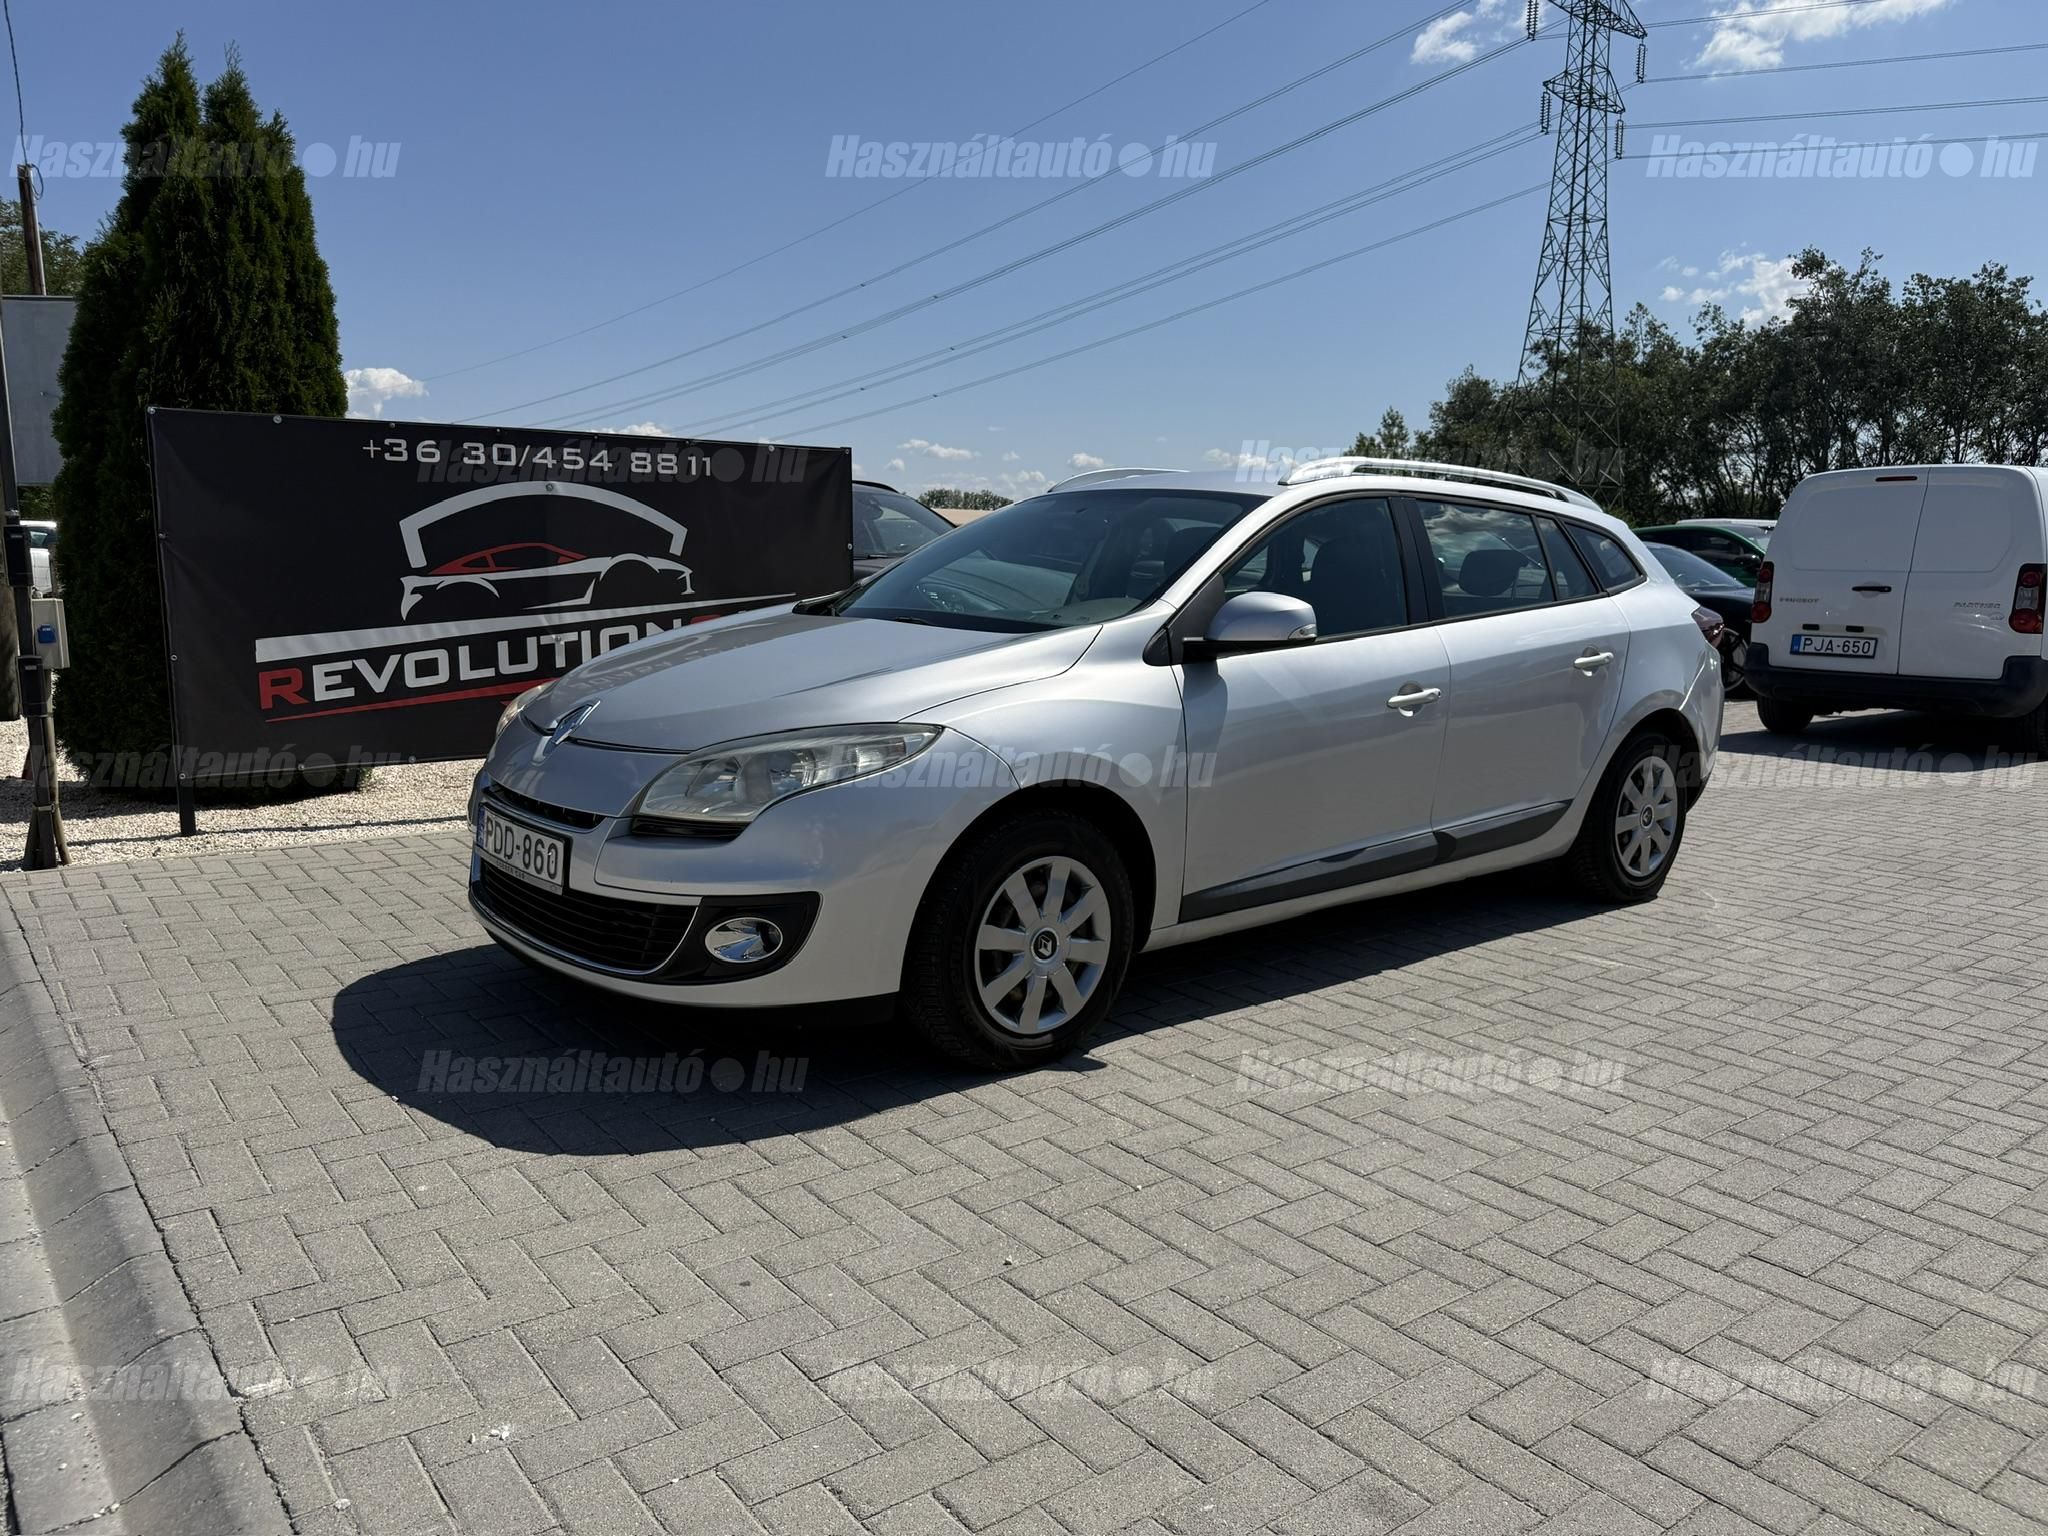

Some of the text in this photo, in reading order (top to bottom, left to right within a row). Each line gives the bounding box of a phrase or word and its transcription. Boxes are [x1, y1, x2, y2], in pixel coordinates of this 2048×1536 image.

[362, 438, 711, 476] +36 30/454 8811
[1802, 637, 1871, 654] PJA-650
[485, 815, 558, 880] PDD-860
